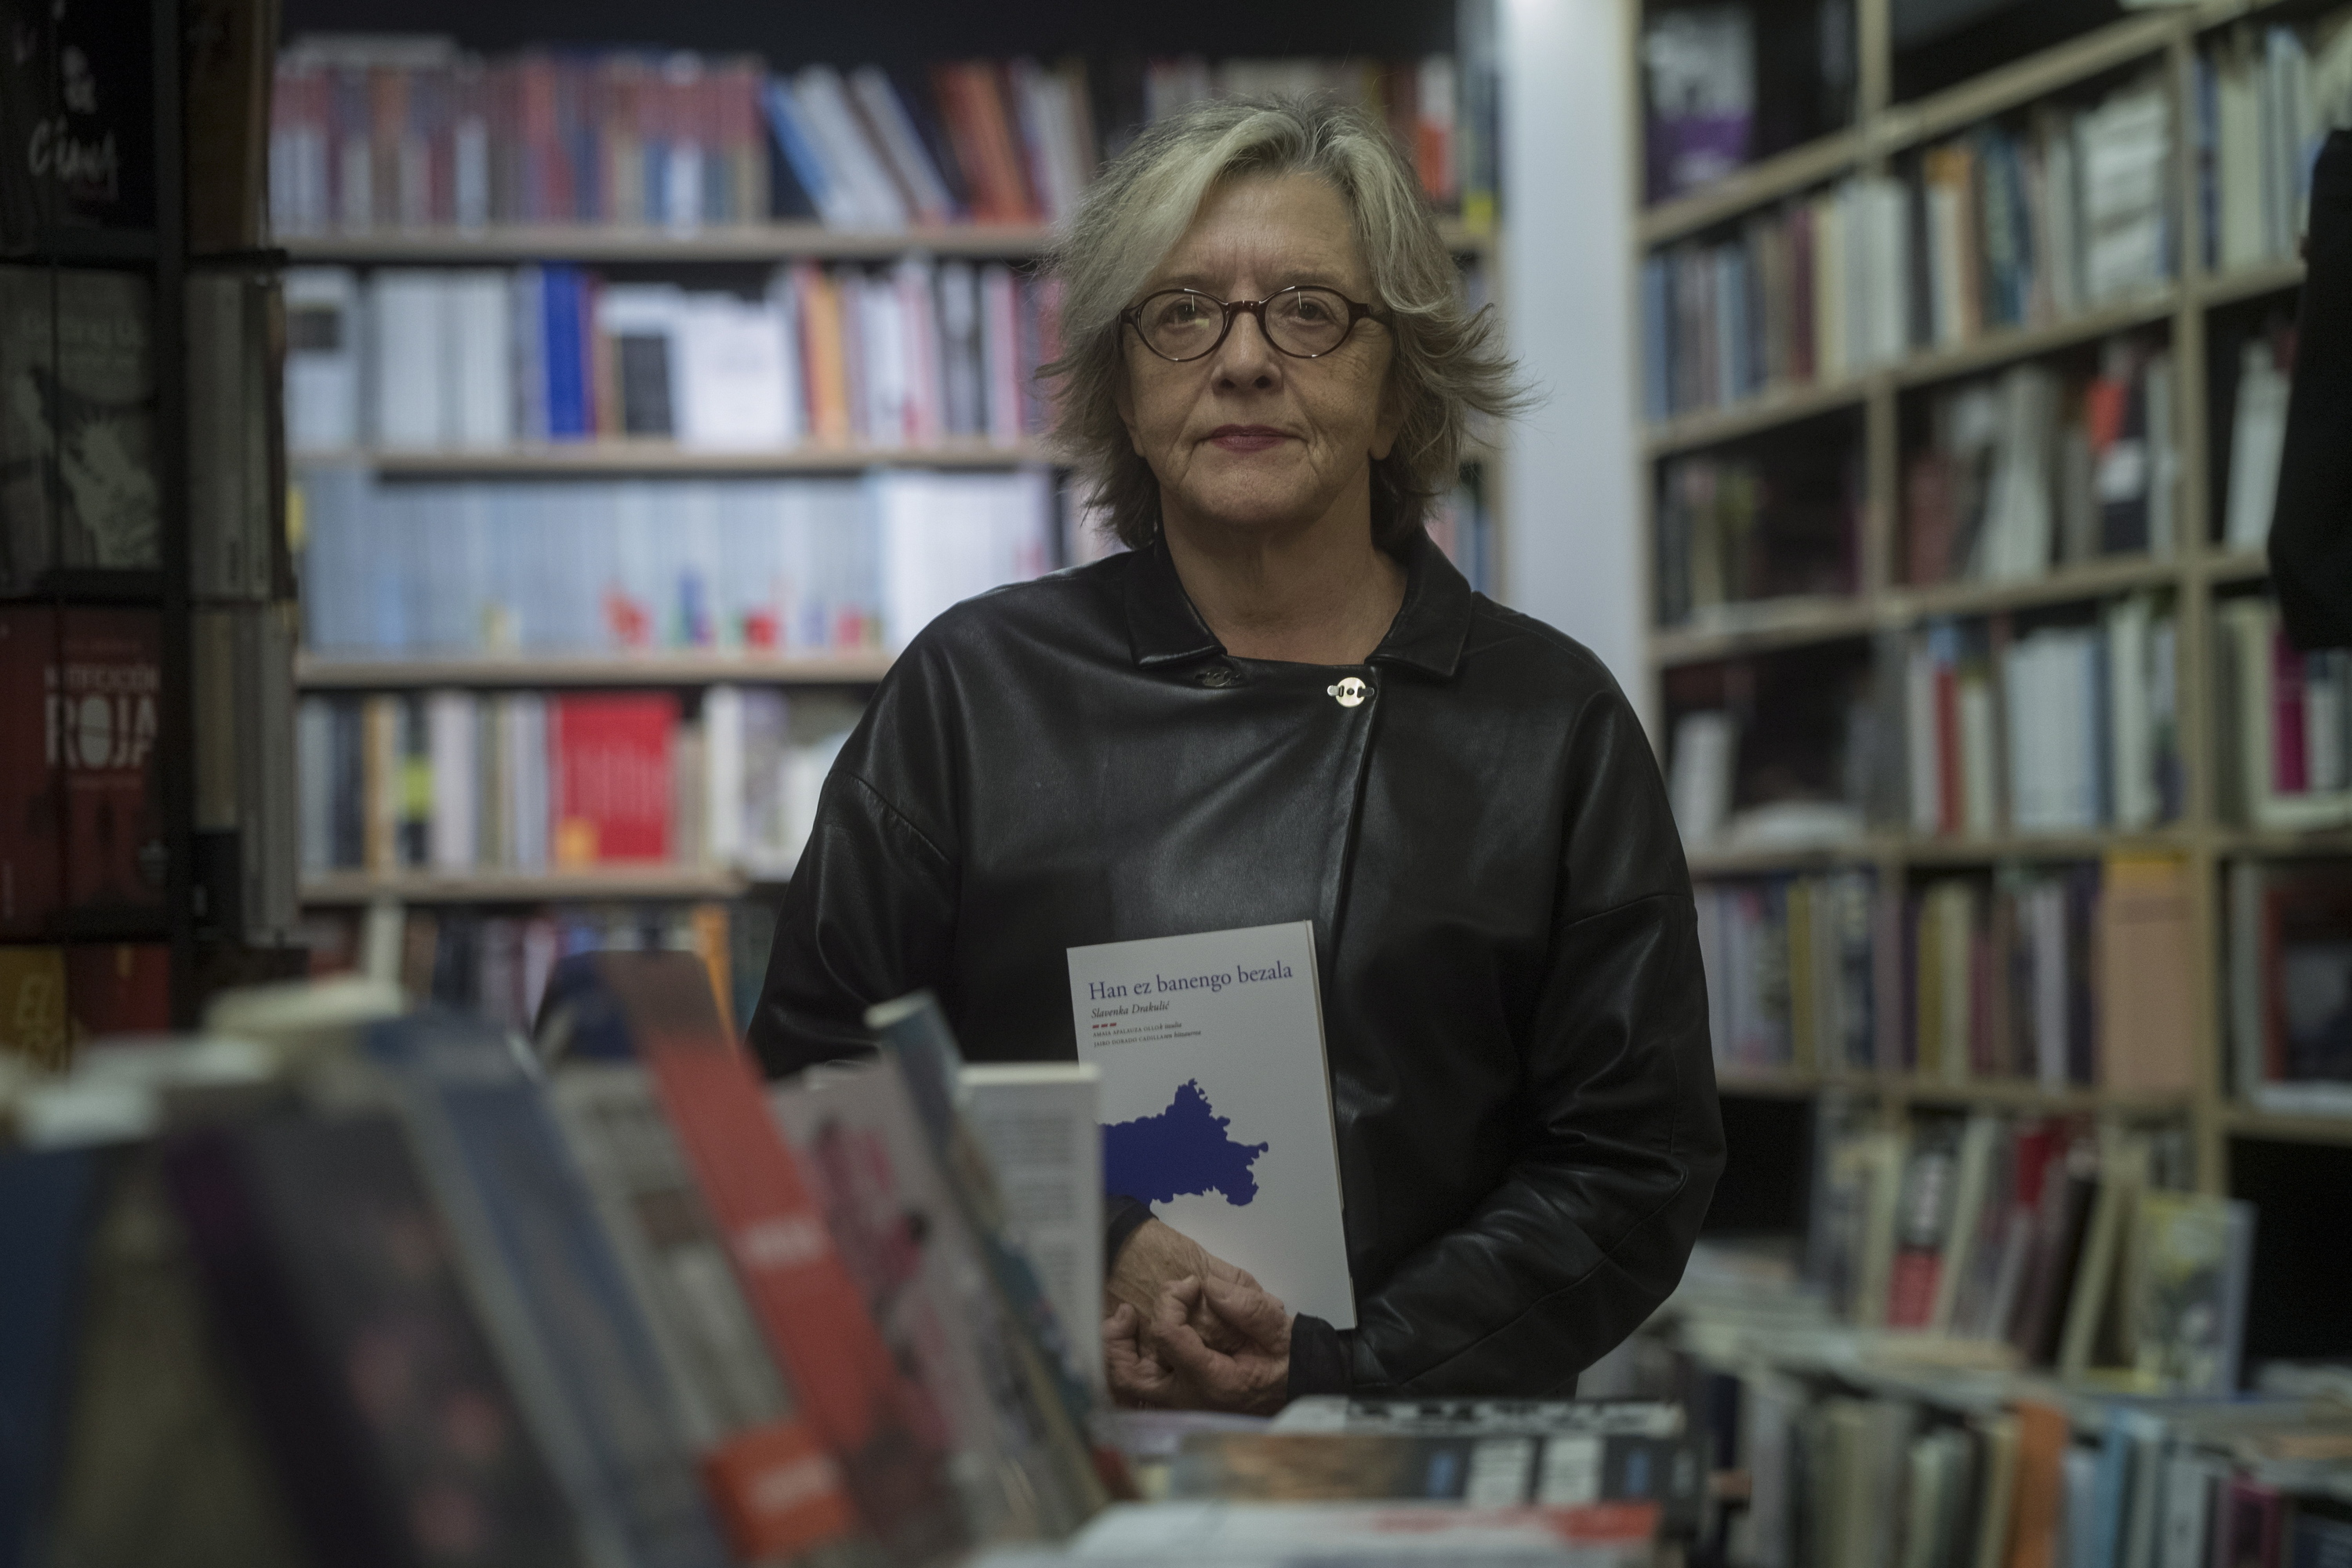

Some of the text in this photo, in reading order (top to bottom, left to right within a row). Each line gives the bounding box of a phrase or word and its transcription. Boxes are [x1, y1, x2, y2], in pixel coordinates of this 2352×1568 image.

[1088, 960, 1293, 1000] Han ez banengo bezala
[1091, 1000, 1170, 1018] Slavenka Drakulić
[1113, 1027, 1142, 1036] APALAUZA
[1094, 1040, 1110, 1048] JAIRO
[1112, 1036, 1138, 1045] DORADO
